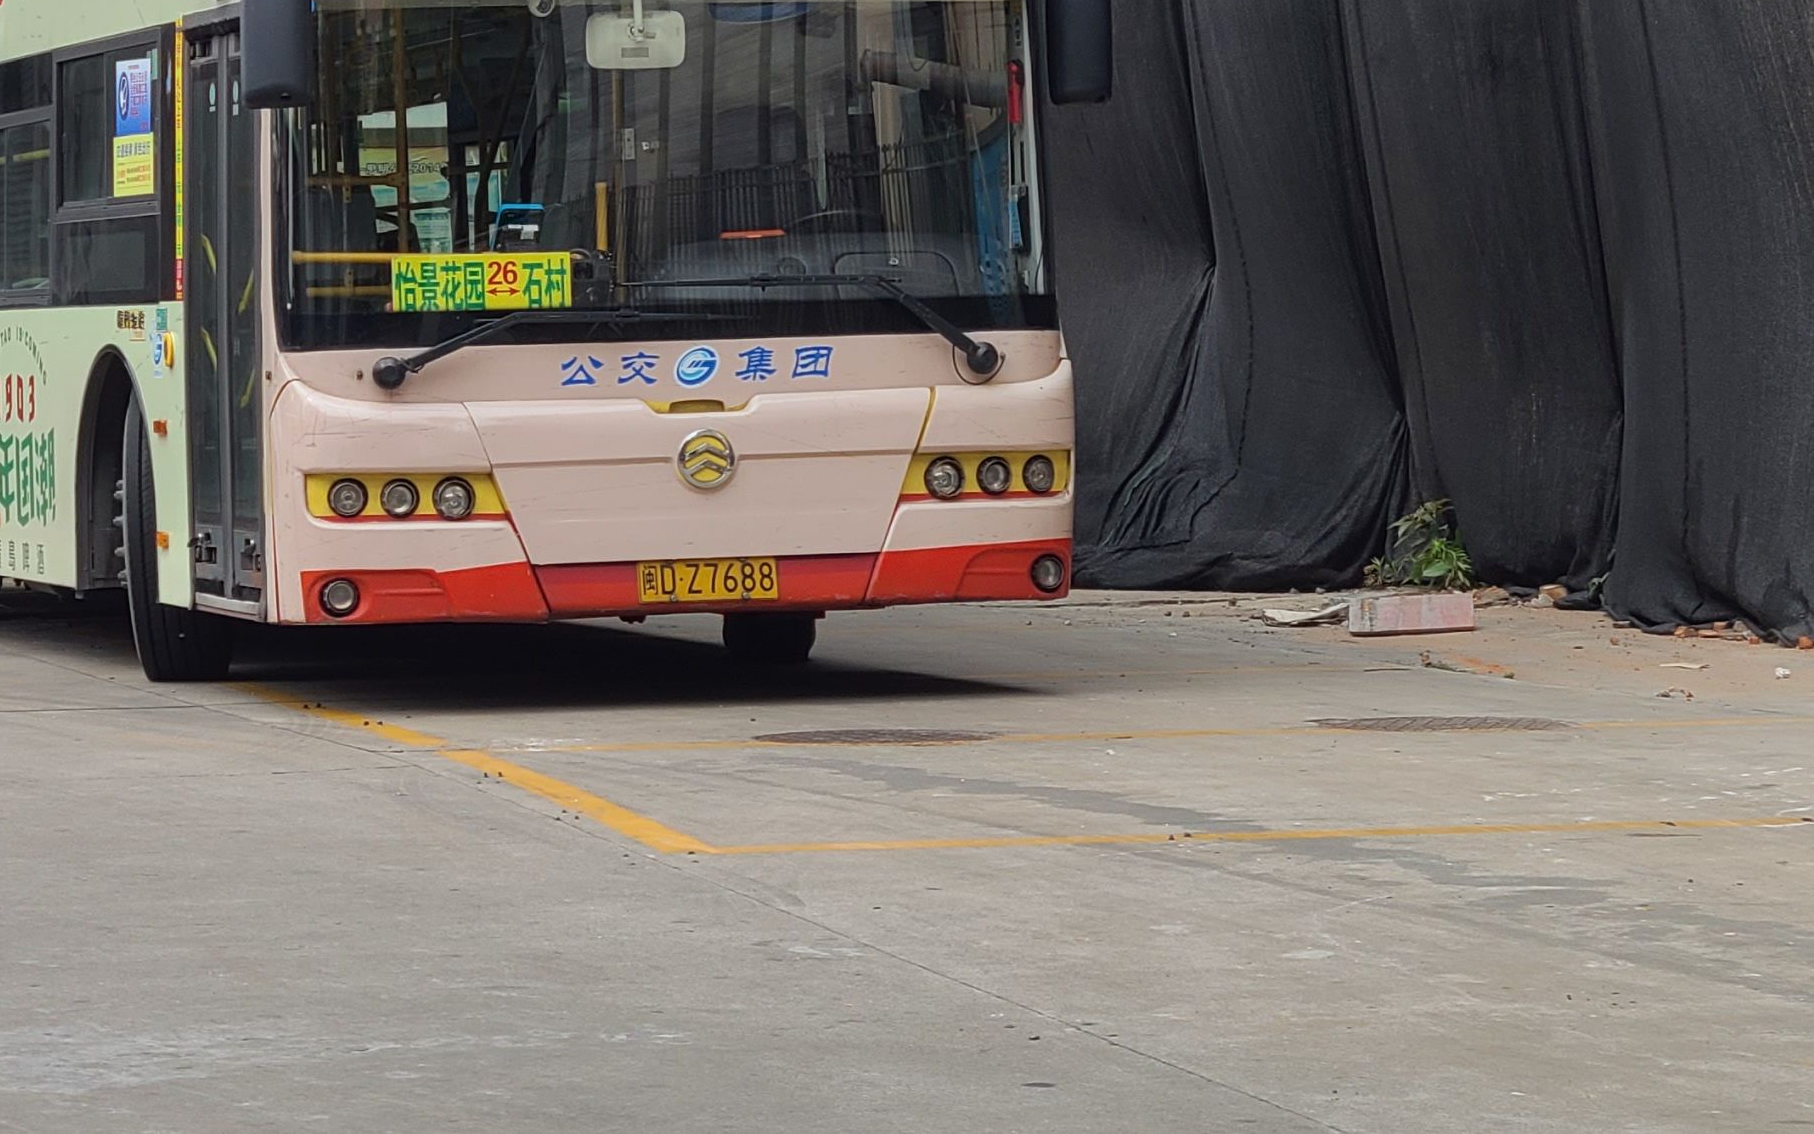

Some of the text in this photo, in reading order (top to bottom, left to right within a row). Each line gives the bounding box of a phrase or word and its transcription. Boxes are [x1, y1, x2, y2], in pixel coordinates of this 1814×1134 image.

[395, 258, 567, 312] 怡景花园 26 石村
[561, 346, 834, 386] 公交 集团
